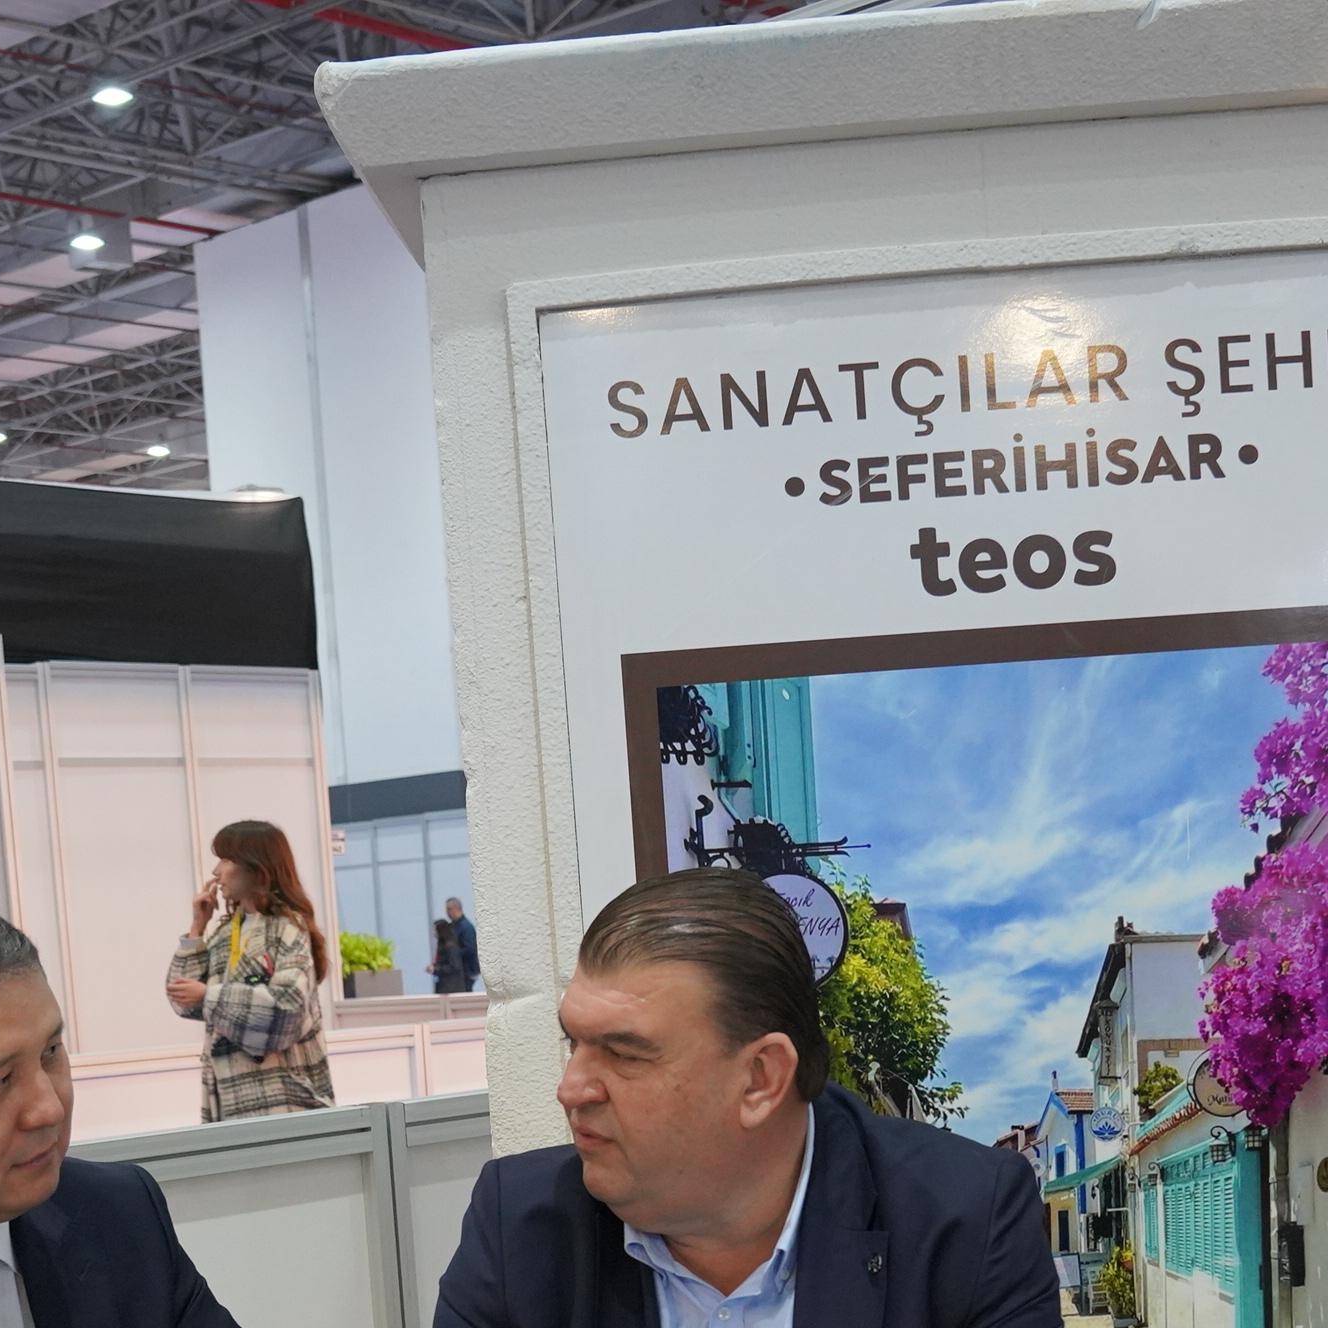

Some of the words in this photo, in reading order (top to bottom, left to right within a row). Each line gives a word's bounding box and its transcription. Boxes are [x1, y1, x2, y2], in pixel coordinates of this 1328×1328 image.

[607, 342, 1131, 437] SANATÇILAR
[818, 427, 1227, 507] SEFERİHİSAR
[909, 525, 1119, 597] teos
